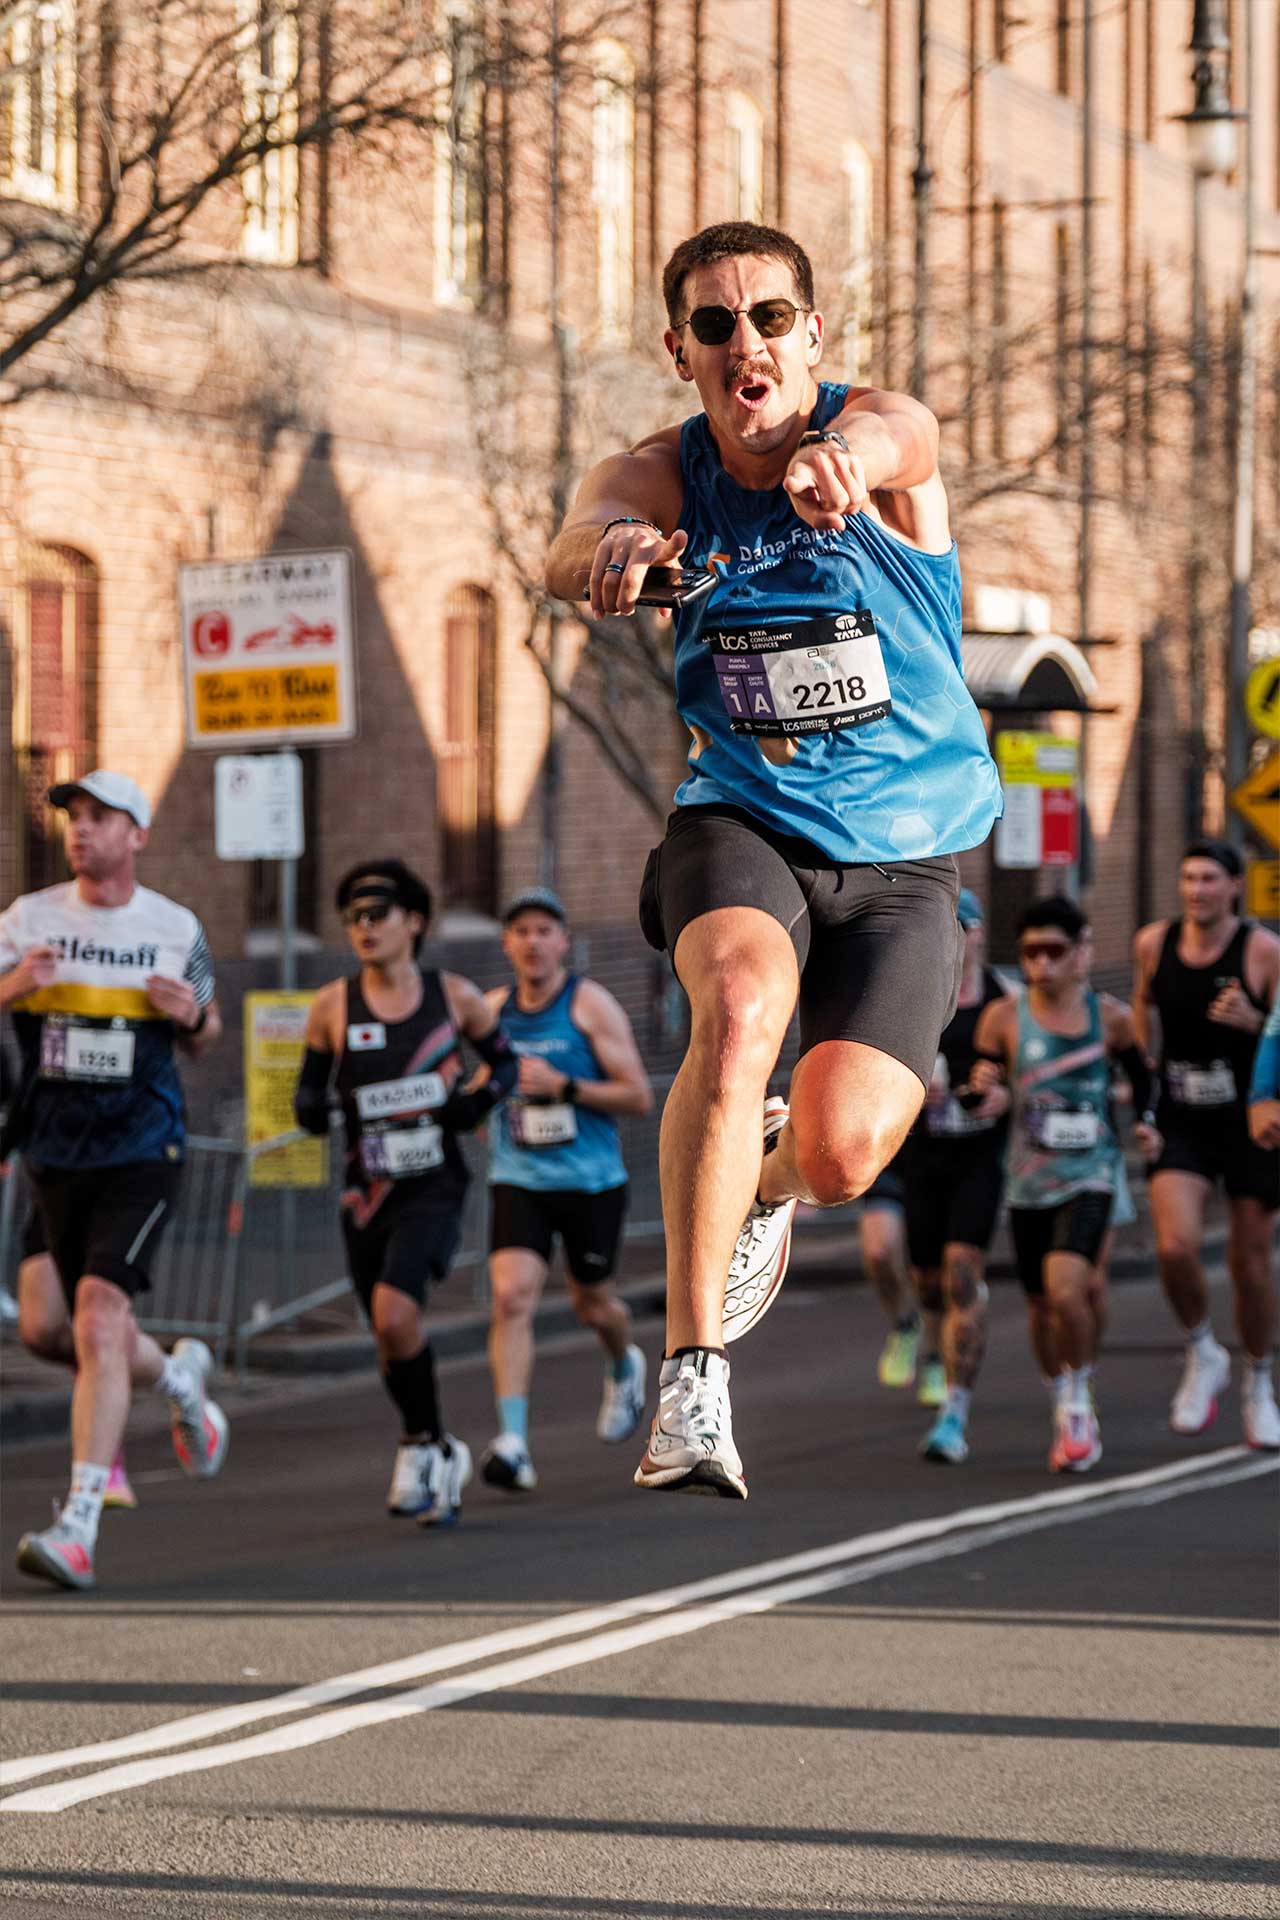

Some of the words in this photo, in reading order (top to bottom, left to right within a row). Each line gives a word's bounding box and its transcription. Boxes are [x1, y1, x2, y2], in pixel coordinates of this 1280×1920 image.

[739, 527, 844, 562] Dana-Farb
[719, 632, 748, 650] tcs
[749, 632, 793, 644] CONSULTANCY
[834, 628, 864, 641] TATA
[751, 641, 779, 650] SERVICES
[730, 693, 743, 713] 1
[755, 693, 772, 713] A
[792, 675, 867, 711] 2218
